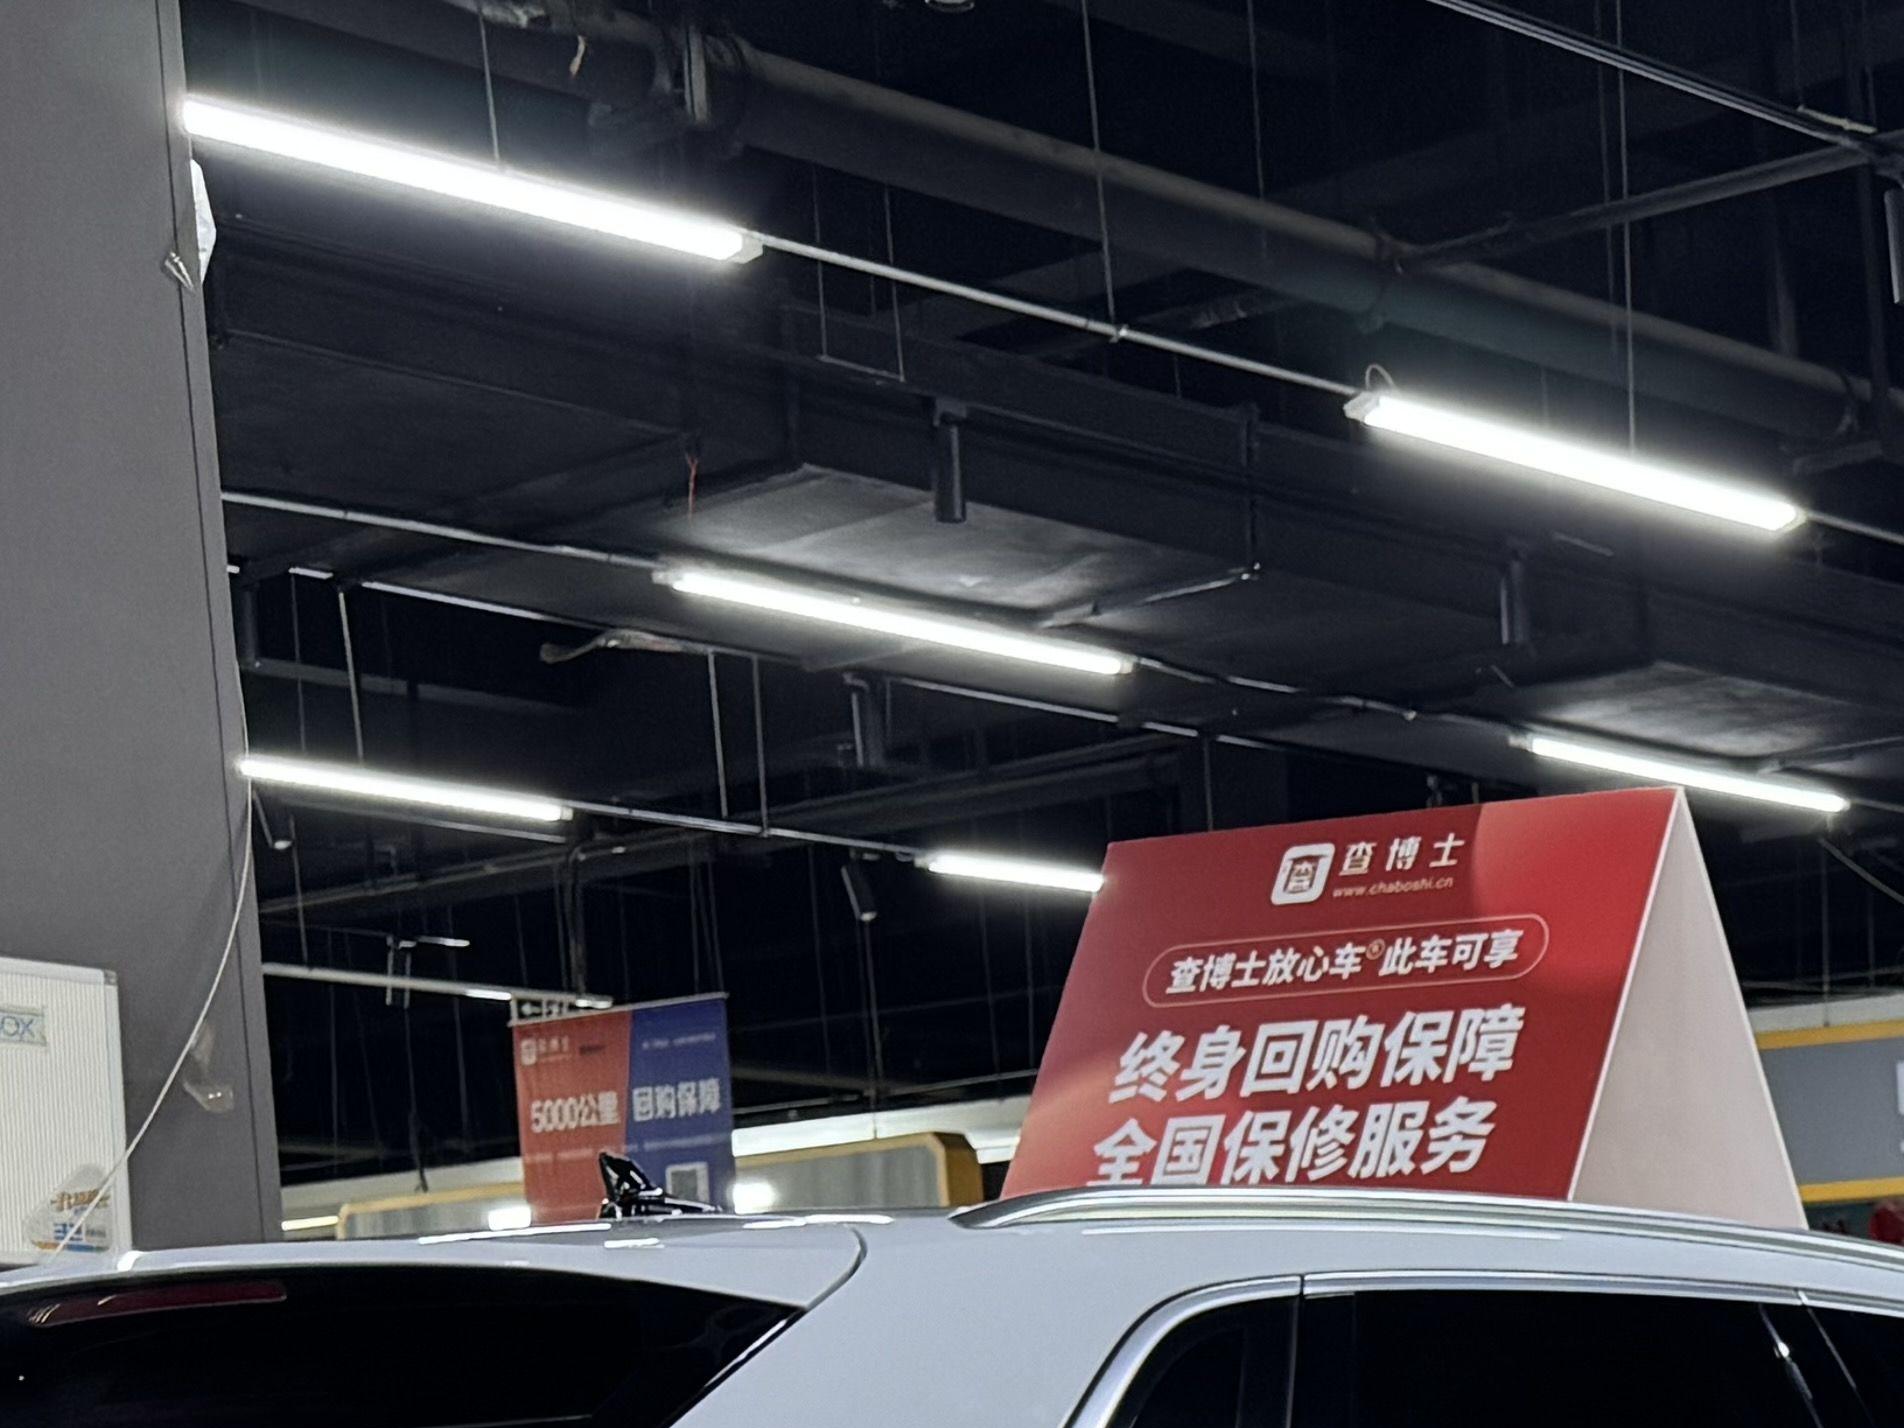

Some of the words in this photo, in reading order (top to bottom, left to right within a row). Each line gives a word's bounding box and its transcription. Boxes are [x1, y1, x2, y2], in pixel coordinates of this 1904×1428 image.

[1332, 876, 1454, 899] www.chaboshi.cn
[1338, 832, 1465, 876] 查博士
[1108, 1004, 1525, 1104] 终身回购保障
[1085, 1097, 1497, 1187] 全国保修服务
